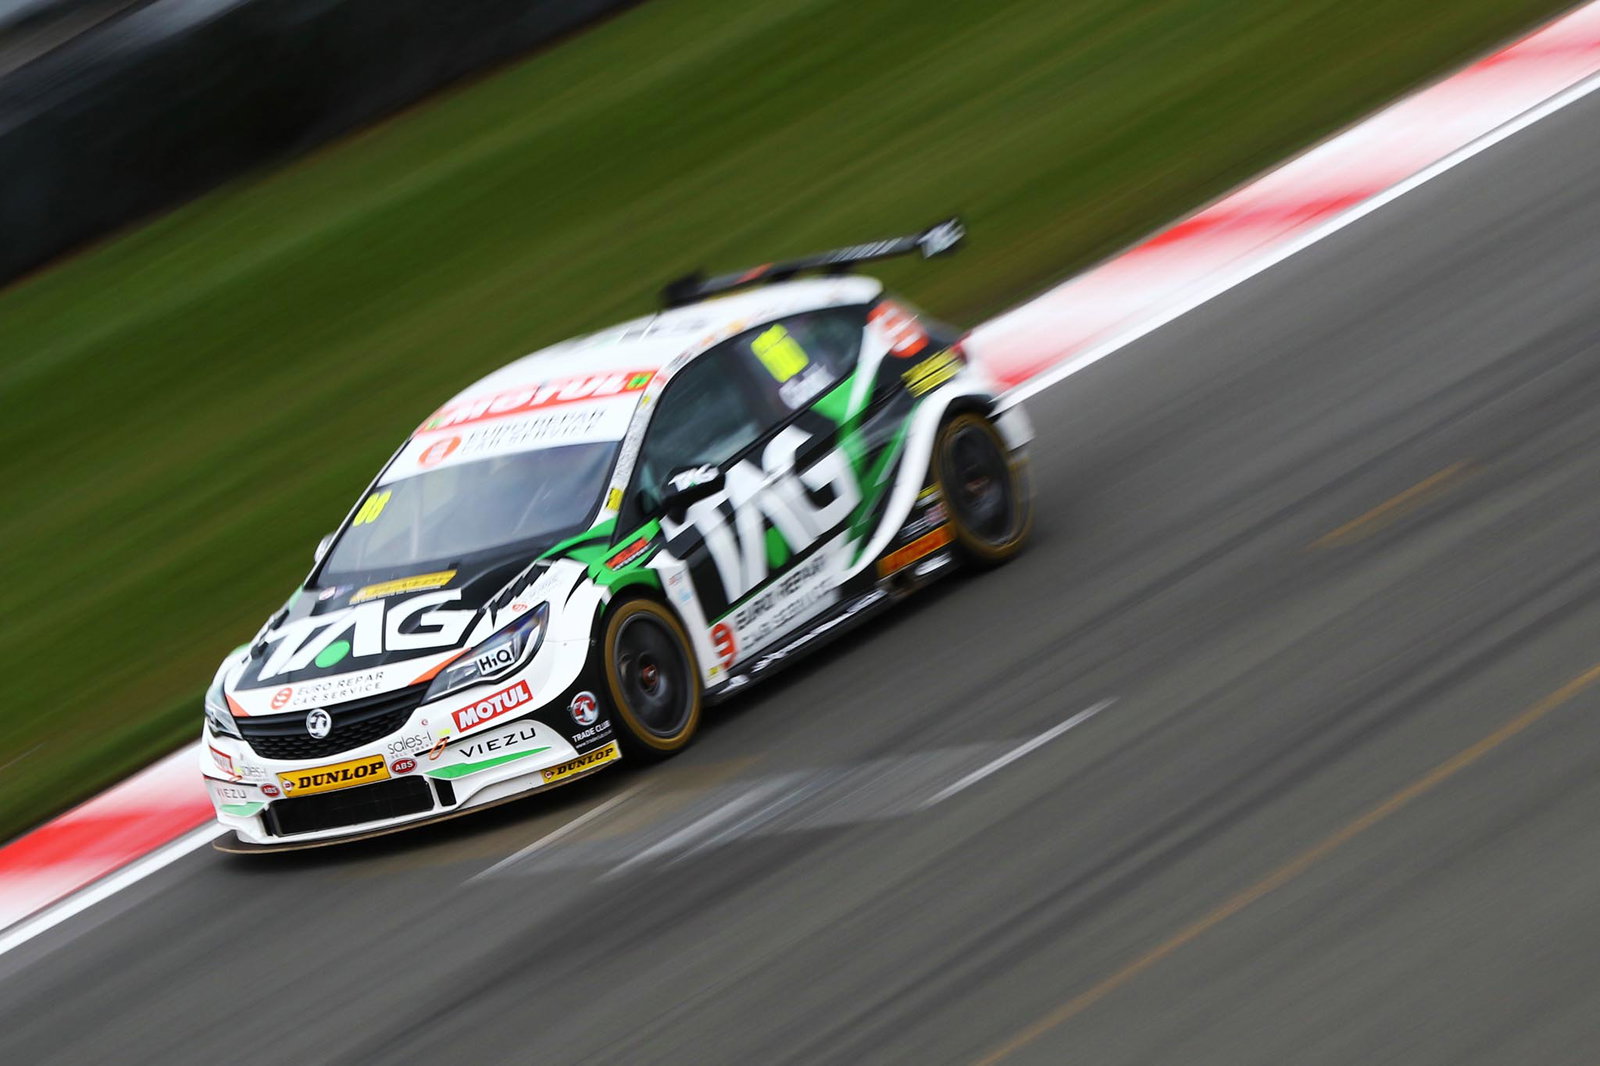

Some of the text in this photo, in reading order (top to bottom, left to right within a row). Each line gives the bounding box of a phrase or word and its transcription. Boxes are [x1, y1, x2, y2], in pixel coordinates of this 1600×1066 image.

[659, 424, 863, 605] TAG
[256, 588, 479, 681] TAG
[479, 650, 512, 671] HiQ
[458, 684, 529, 730] MOTUL
[459, 727, 536, 757] VIEZU
[572, 727, 595, 742] TRADE
[298, 761, 384, 789] DUNLOP
[395, 760, 414, 772] ABS
[556, 747, 613, 775] DUNLOP
